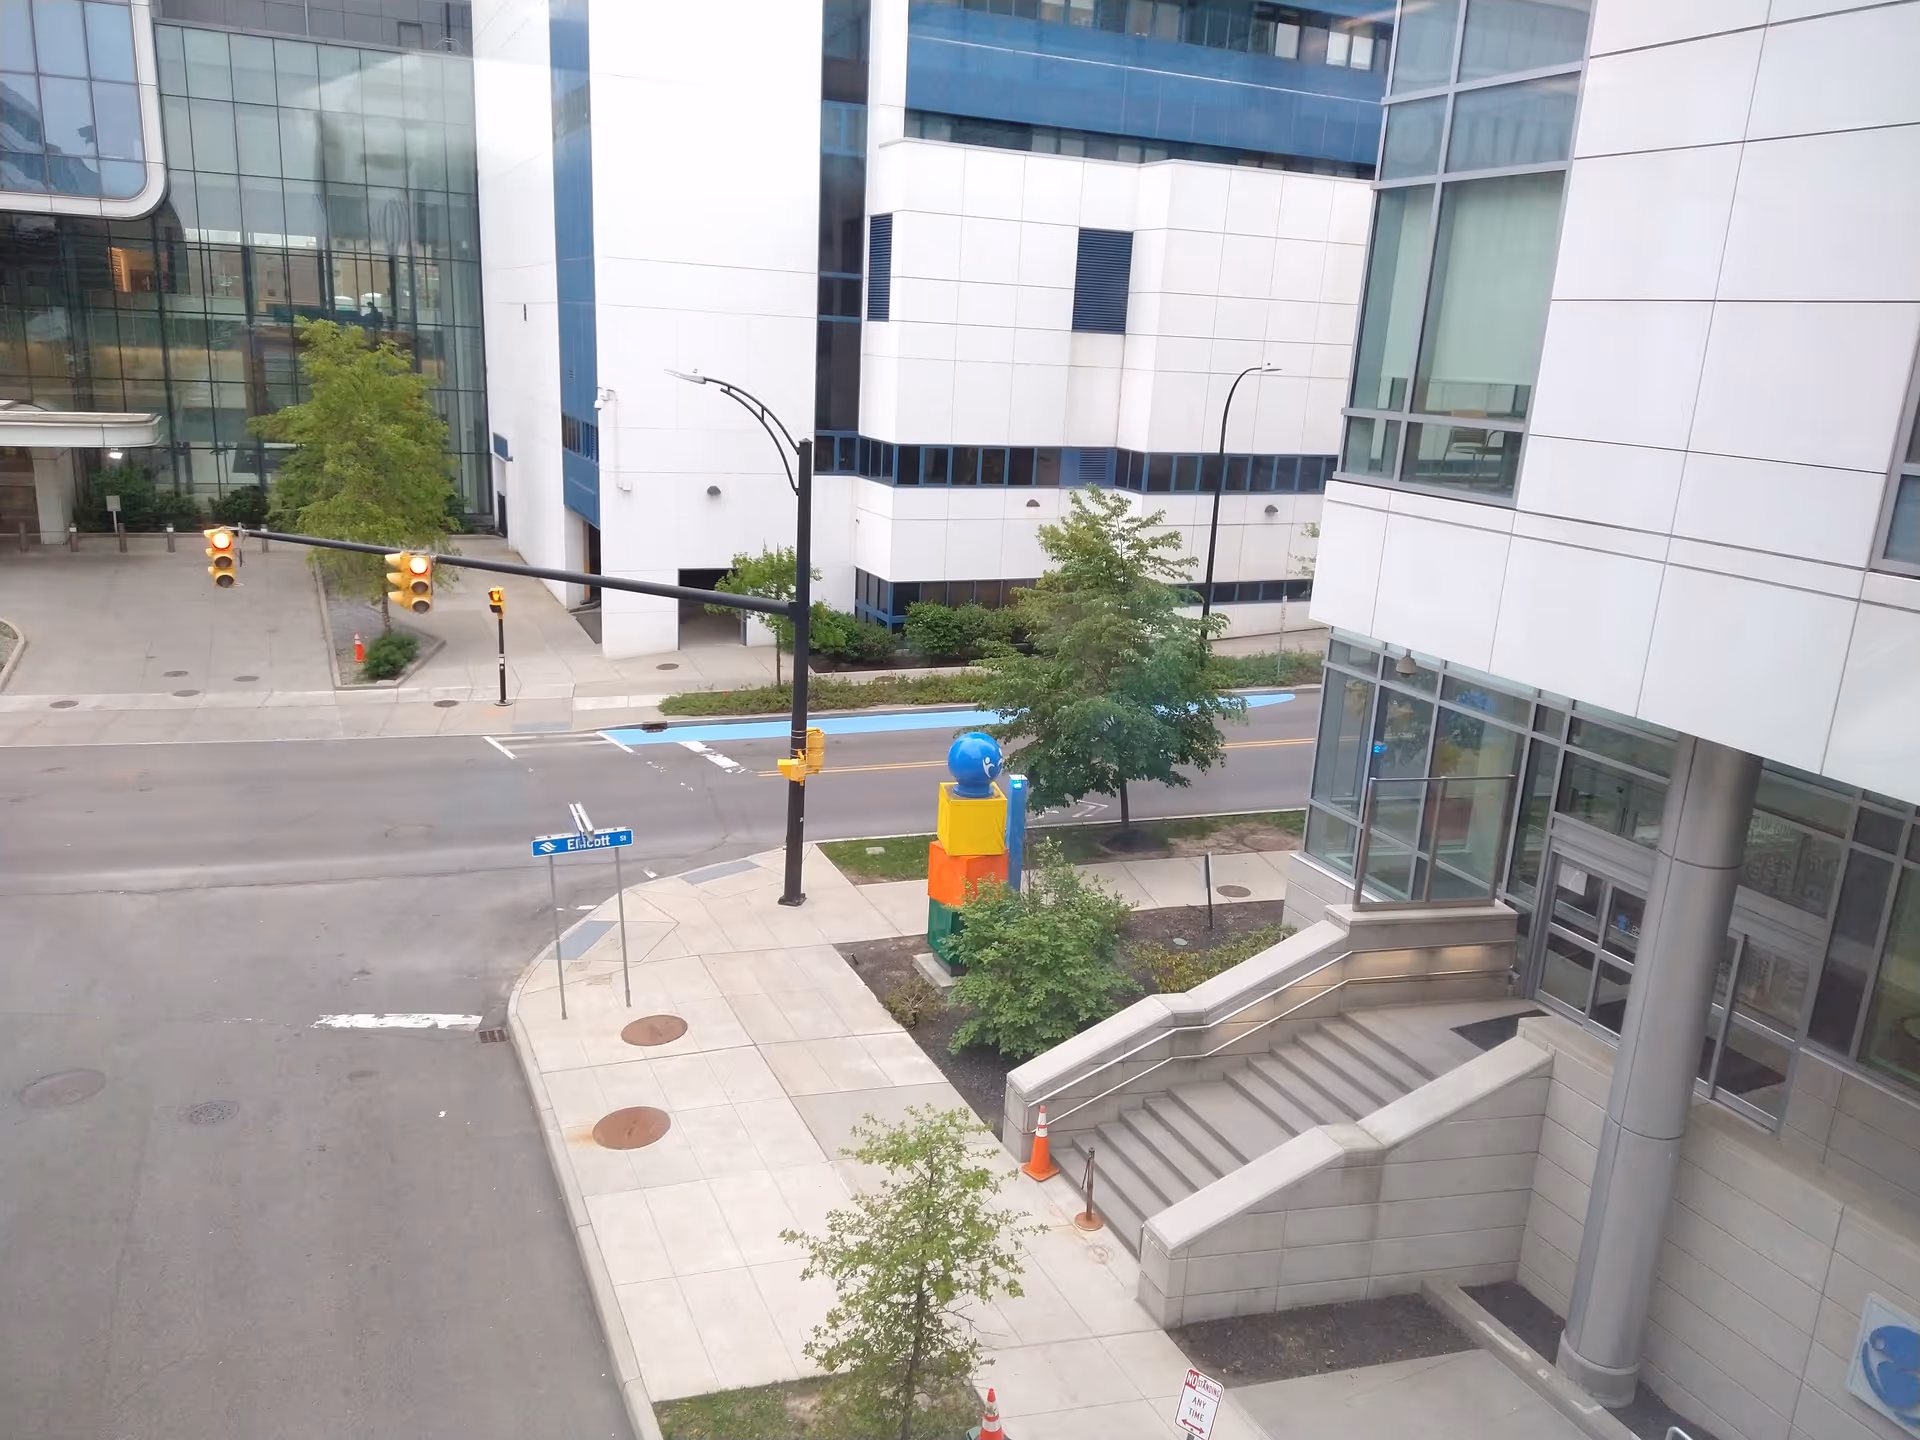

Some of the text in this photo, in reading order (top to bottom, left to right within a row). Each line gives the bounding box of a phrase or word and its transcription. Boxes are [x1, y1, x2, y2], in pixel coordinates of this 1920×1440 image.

[1187, 1372, 1220, 1398] NO STANDING
[1192, 1396, 1207, 1409] ANY
[1188, 1407, 1204, 1422] TIME
